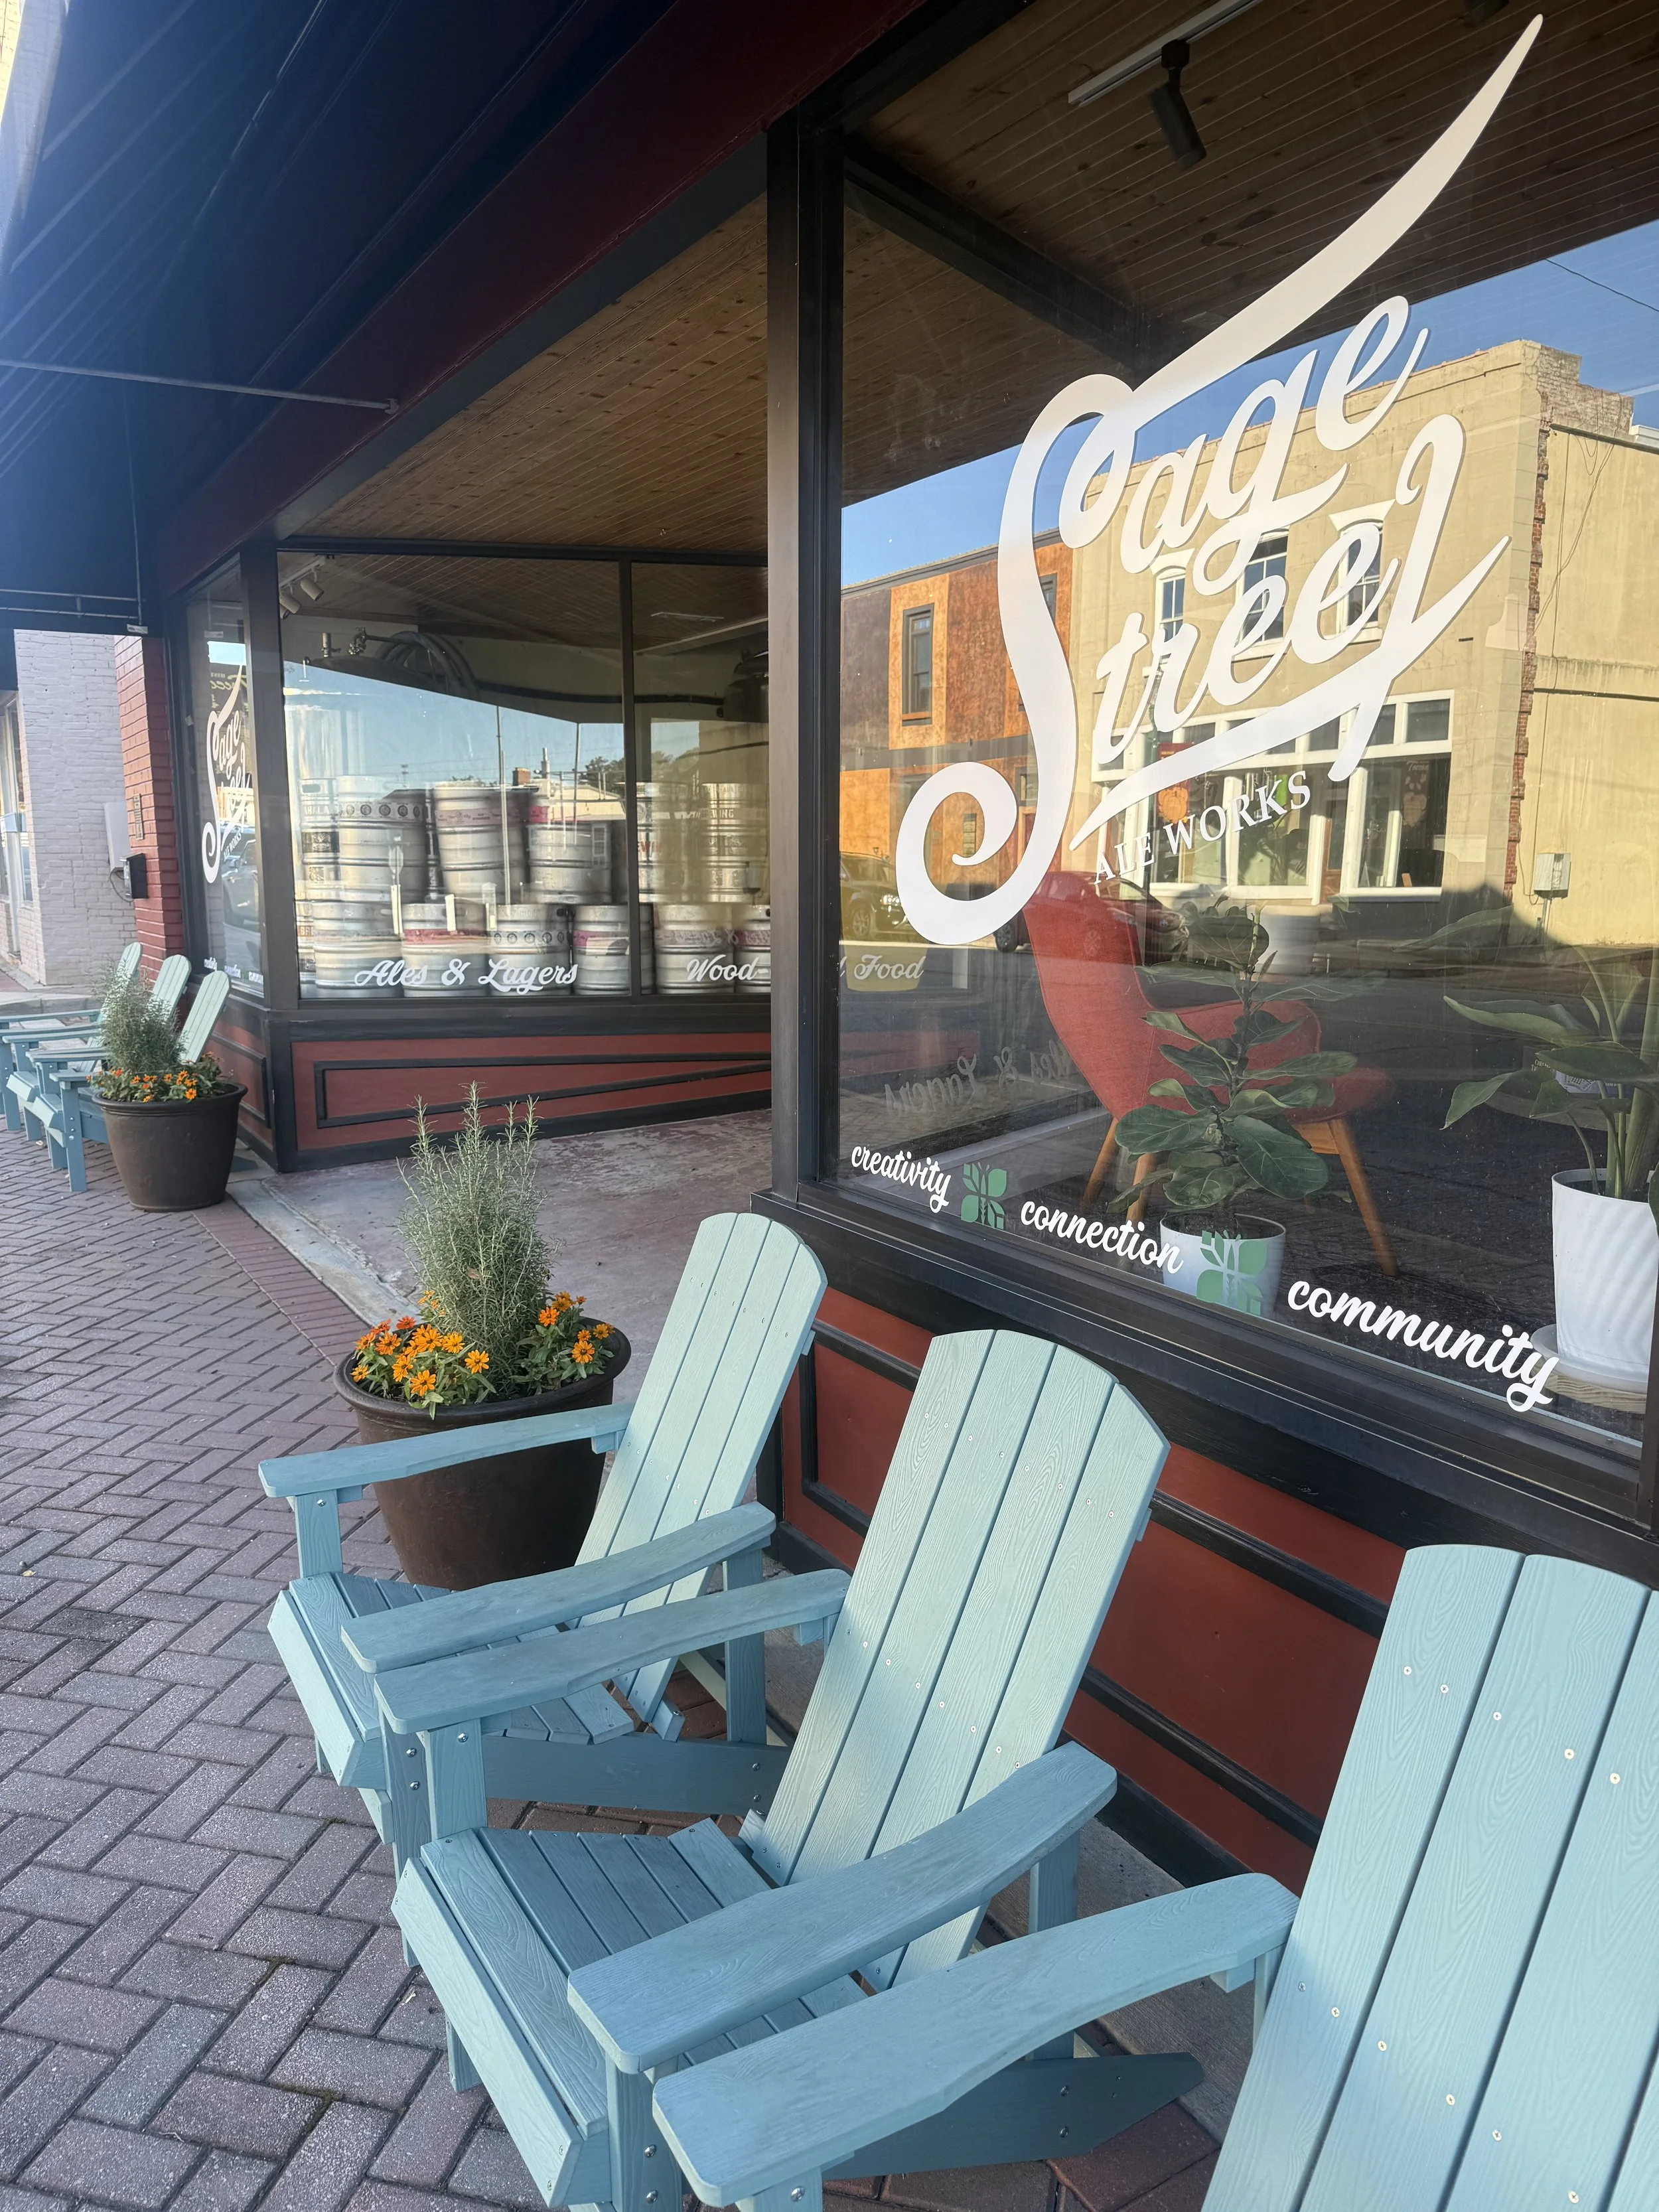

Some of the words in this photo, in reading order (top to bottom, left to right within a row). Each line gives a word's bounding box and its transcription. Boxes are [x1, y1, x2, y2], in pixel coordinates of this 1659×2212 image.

[1094, 832, 1155, 885] ALE
[1163, 771, 1311, 856] WORKS
[354, 960, 428, 987] Ales
[441, 958, 472, 986] &
[478, 958, 579, 995] Lagers
[853, 954, 926, 981] Food
[850, 1144, 952, 1214] creativity
[1020, 1201, 1185, 1276] connection
[1287, 1280, 1560, 1413] community
